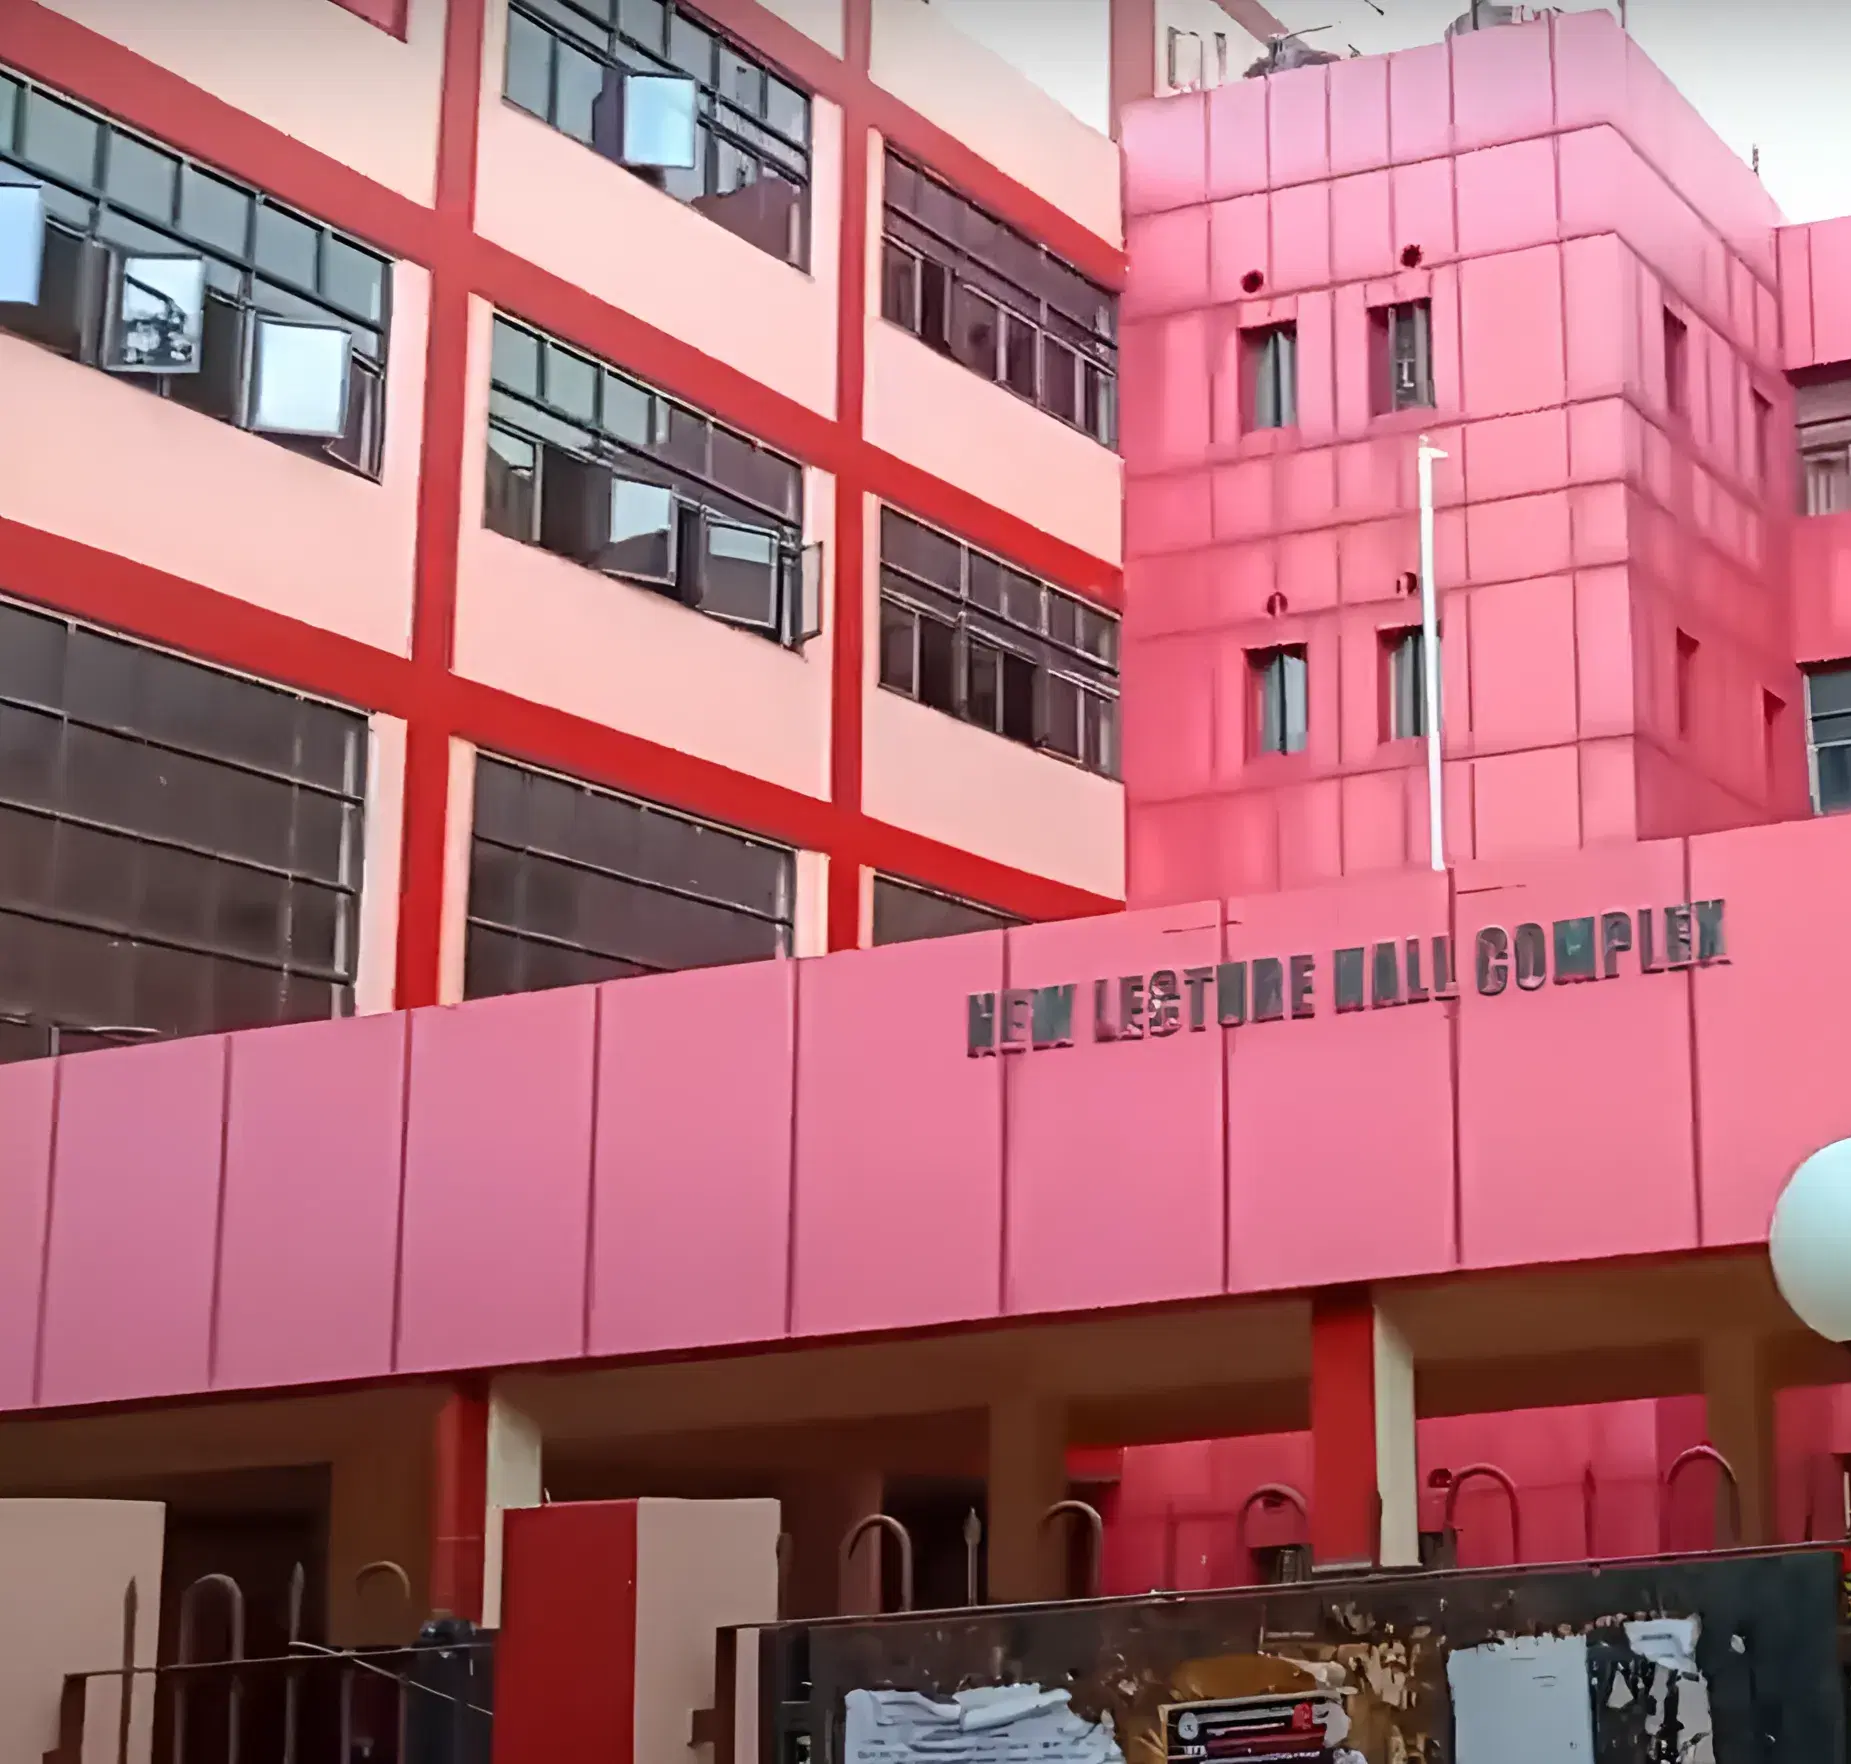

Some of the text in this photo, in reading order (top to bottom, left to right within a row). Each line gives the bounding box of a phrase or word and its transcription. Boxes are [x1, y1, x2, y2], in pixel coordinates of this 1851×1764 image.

[966, 898, 1733, 1058] NEW LECTURE HALL COMPLEX
